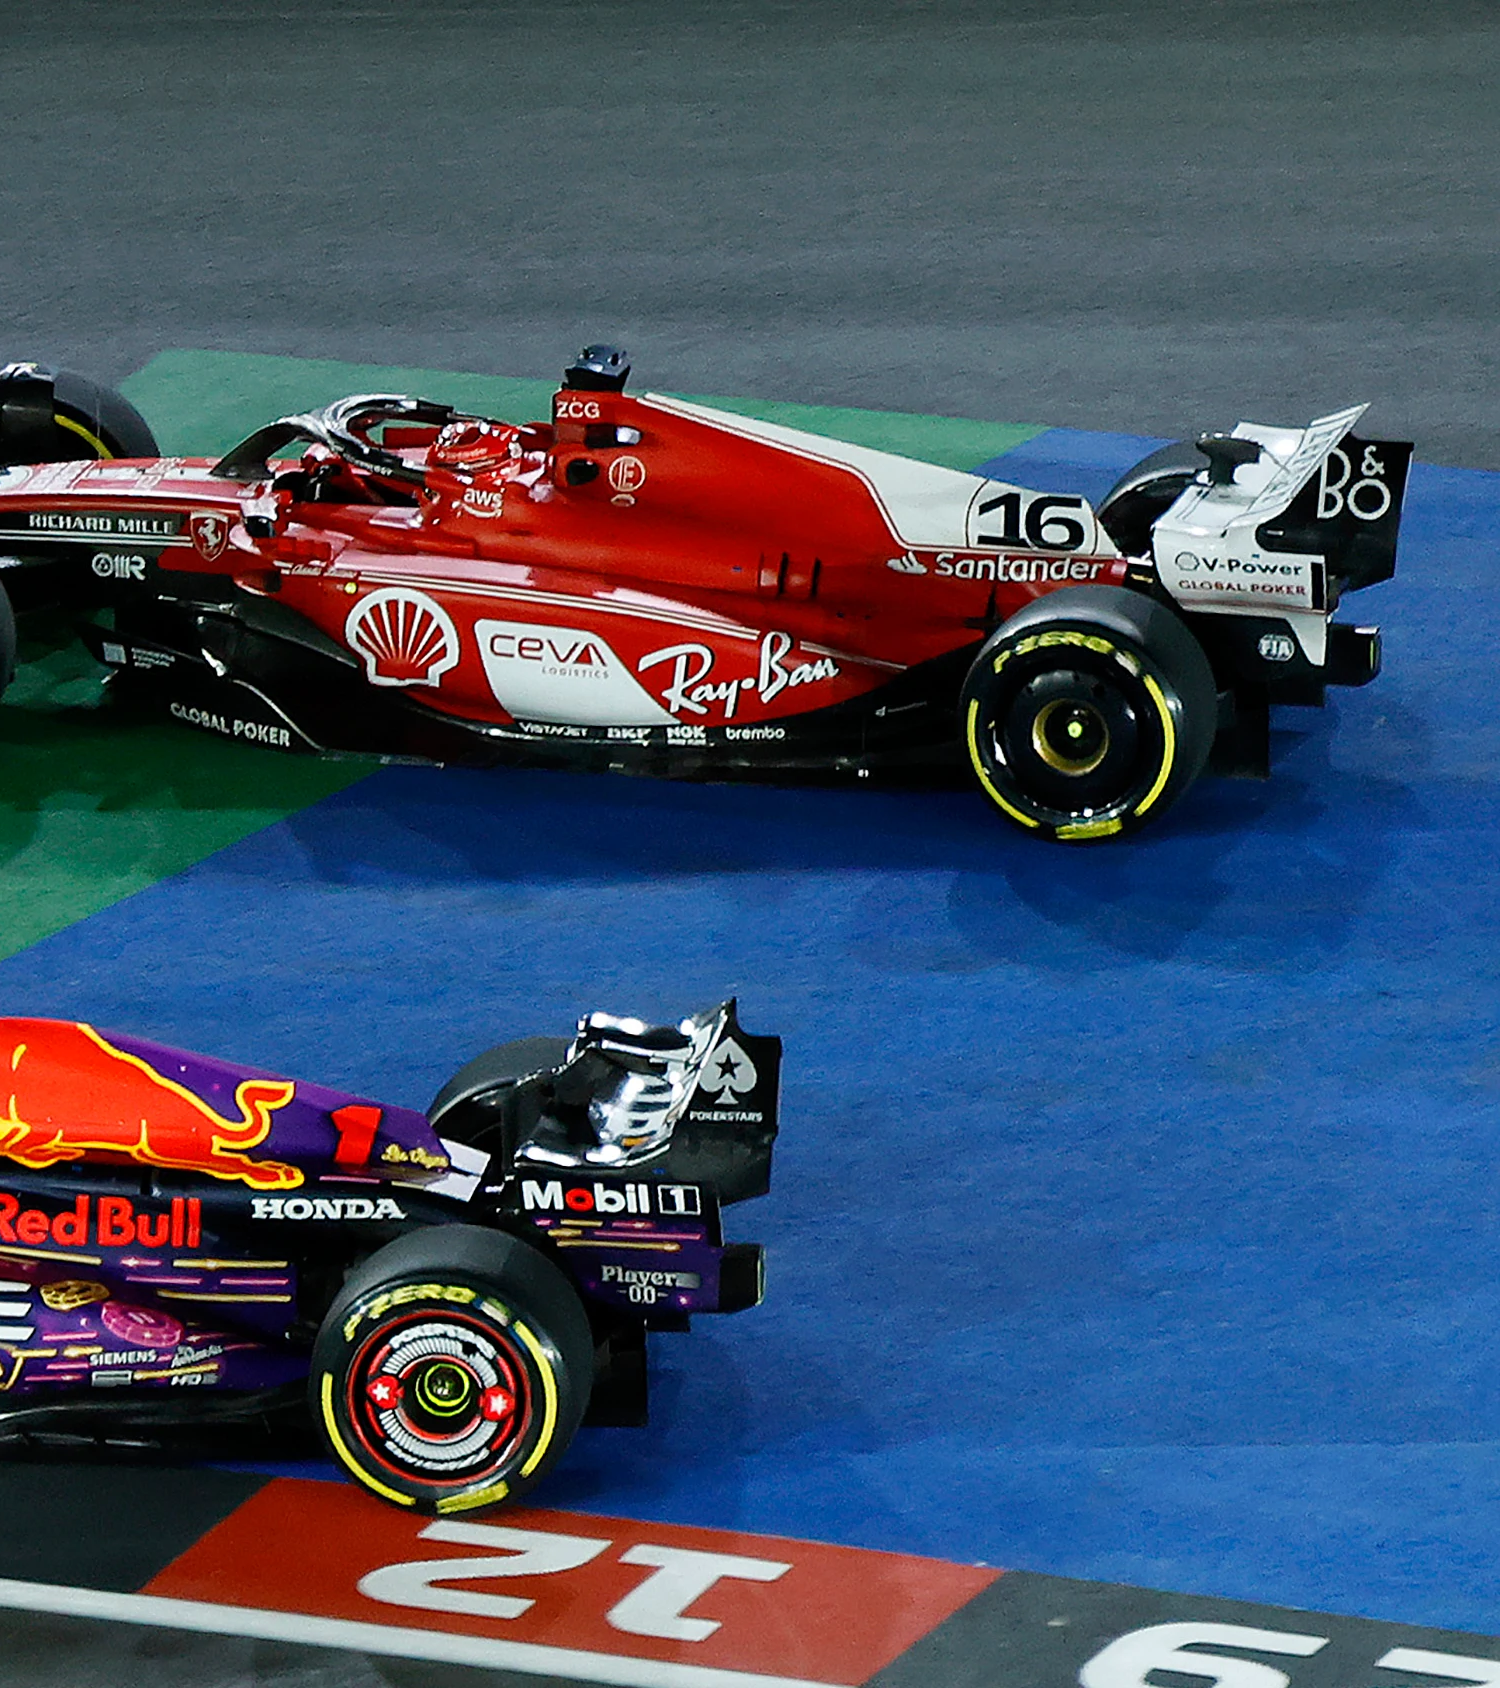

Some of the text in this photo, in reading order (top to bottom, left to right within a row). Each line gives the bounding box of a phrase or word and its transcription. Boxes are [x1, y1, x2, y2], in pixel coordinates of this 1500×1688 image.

[556, 402, 600, 418] ZCG
[464, 488, 503, 508] aws
[29, 514, 173, 534] RICHARD MILLE
[977, 492, 1085, 551] 16
[935, 553, 1105, 582] Santander
[1202, 557, 1304, 576] V-Power
[1178, 580, 1307, 596] GLOBAL POKER
[542, 667, 609, 680] LOGISTICS
[170, 702, 290, 747] GLOBAL POKER
[725, 727, 786, 740] brembo
[689, 1110, 763, 1123] POKERSTARS
[330, 1104, 383, 1164] 1
[522, 1180, 650, 1214] Mobil
[251, 1198, 407, 1221] HONDA
[97, 1196, 201, 1249] Bull
[90, 1349, 157, 1366] SIEMENS
[356, 1519, 795, 1642] 12
